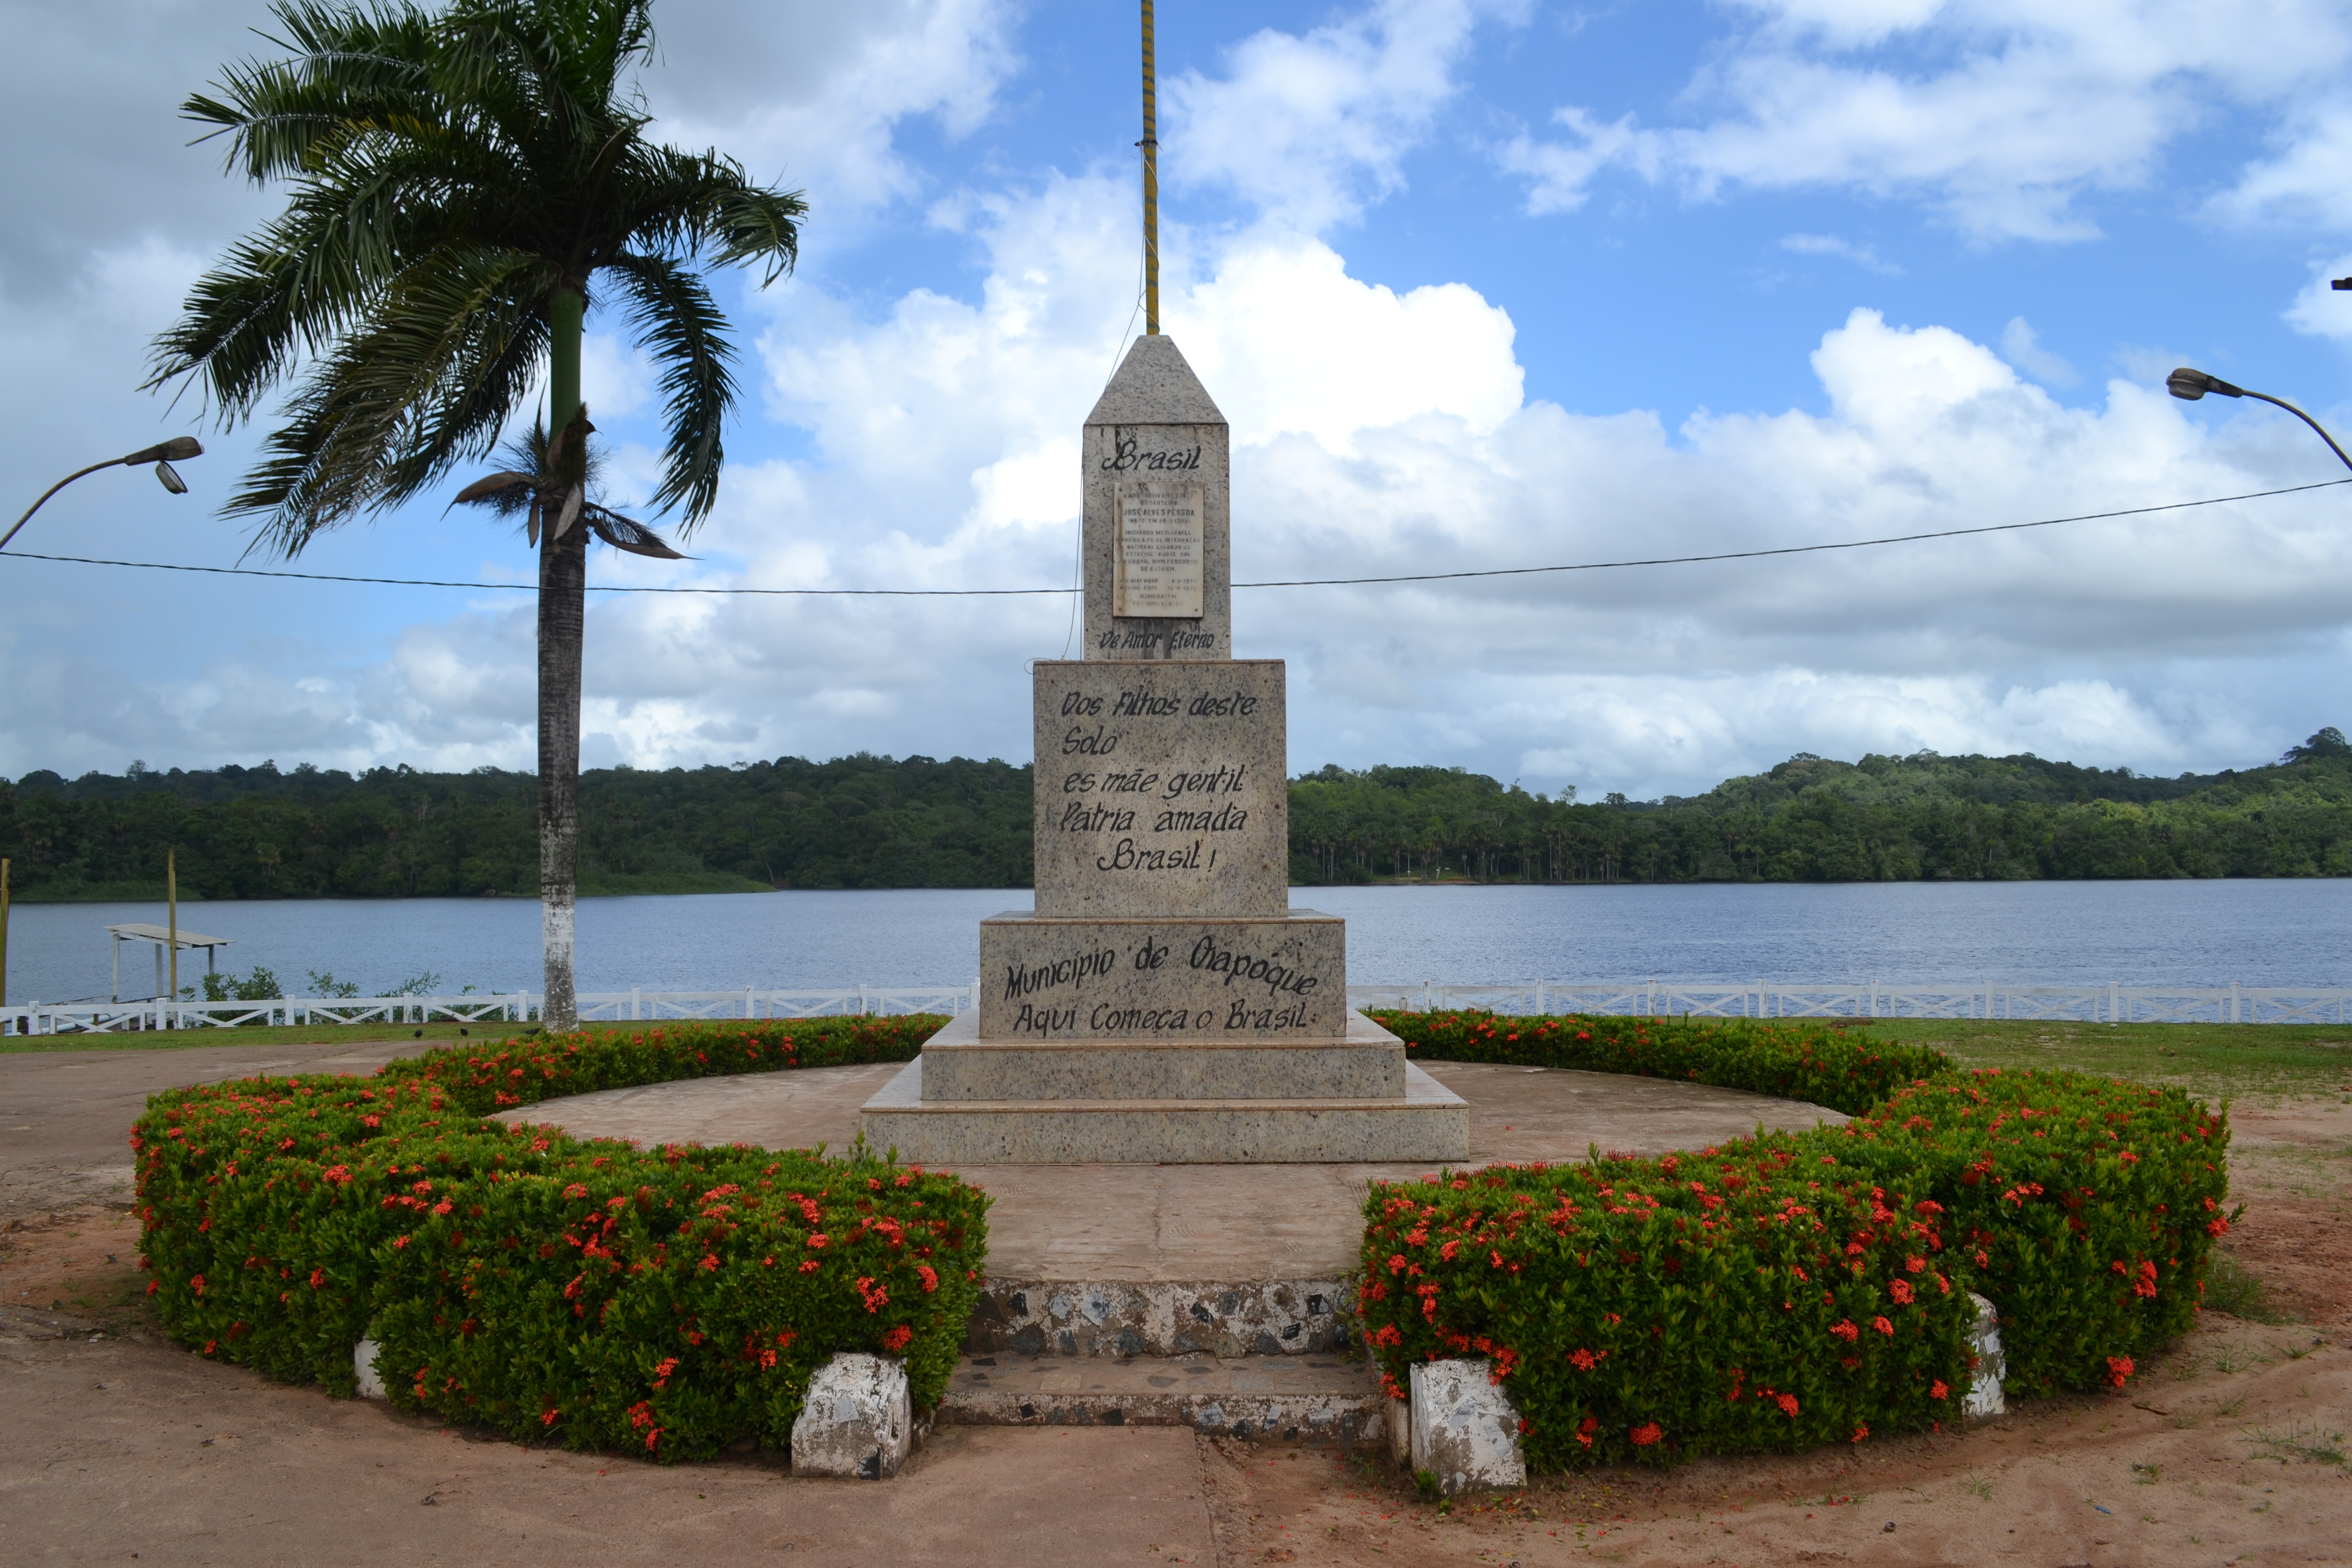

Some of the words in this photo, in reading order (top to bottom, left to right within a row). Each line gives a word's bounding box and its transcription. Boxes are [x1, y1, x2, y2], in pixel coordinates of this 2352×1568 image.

[1101, 440, 1201, 471] Brasil
[1099, 631, 1119, 649] De
[1121, 631, 1163, 650] Amor
[1169, 630, 1215, 651] Eterno
[1061, 691, 1104, 717] Dos
[1188, 691, 1257, 717] deste
[1062, 725, 1118, 755] Solo
[1063, 771, 1096, 793] es
[1101, 768, 1158, 793] mãe
[1162, 764, 1245, 800] gentil
[1154, 802, 1248, 832] amada
[1135, 936, 1169, 971] de
[1190, 935, 1318, 997] Oiapoque
[1013, 1004, 1076, 1039] Aqui
[1196, 1010, 1214, 1028] o
[1224, 998, 1307, 1031] Brasil
